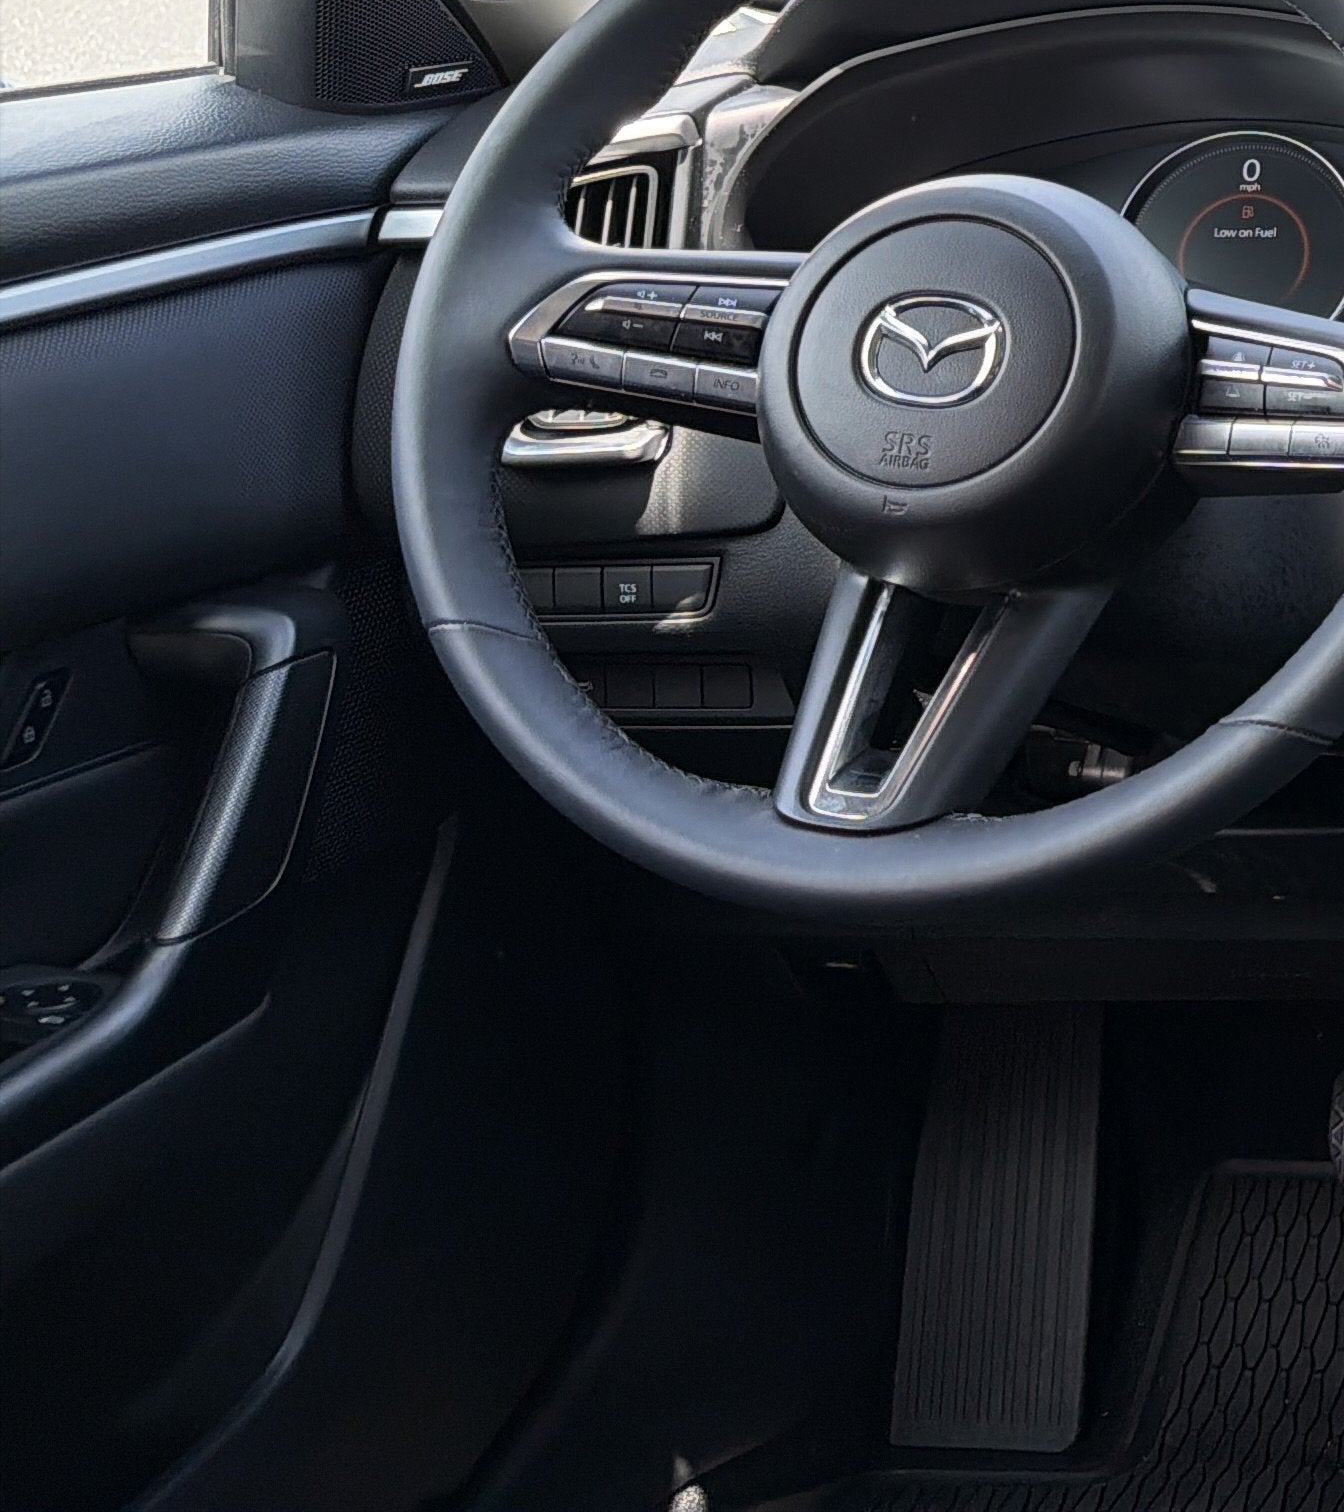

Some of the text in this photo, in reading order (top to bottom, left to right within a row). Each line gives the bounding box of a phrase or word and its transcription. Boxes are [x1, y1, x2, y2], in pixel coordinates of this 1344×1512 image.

[413, 69, 469, 88] BOSE
[1242, 158, 1261, 182] 0
[1239, 182, 1261, 193] mph
[1213, 226, 1277, 238] Low on Fuel
[713, 379, 740, 392] INFO
[881, 430, 932, 457] SRS
[878, 454, 931, 470] AIRBAG
[618, 583, 637, 593] TCS
[619, 594, 637, 604] OFF
